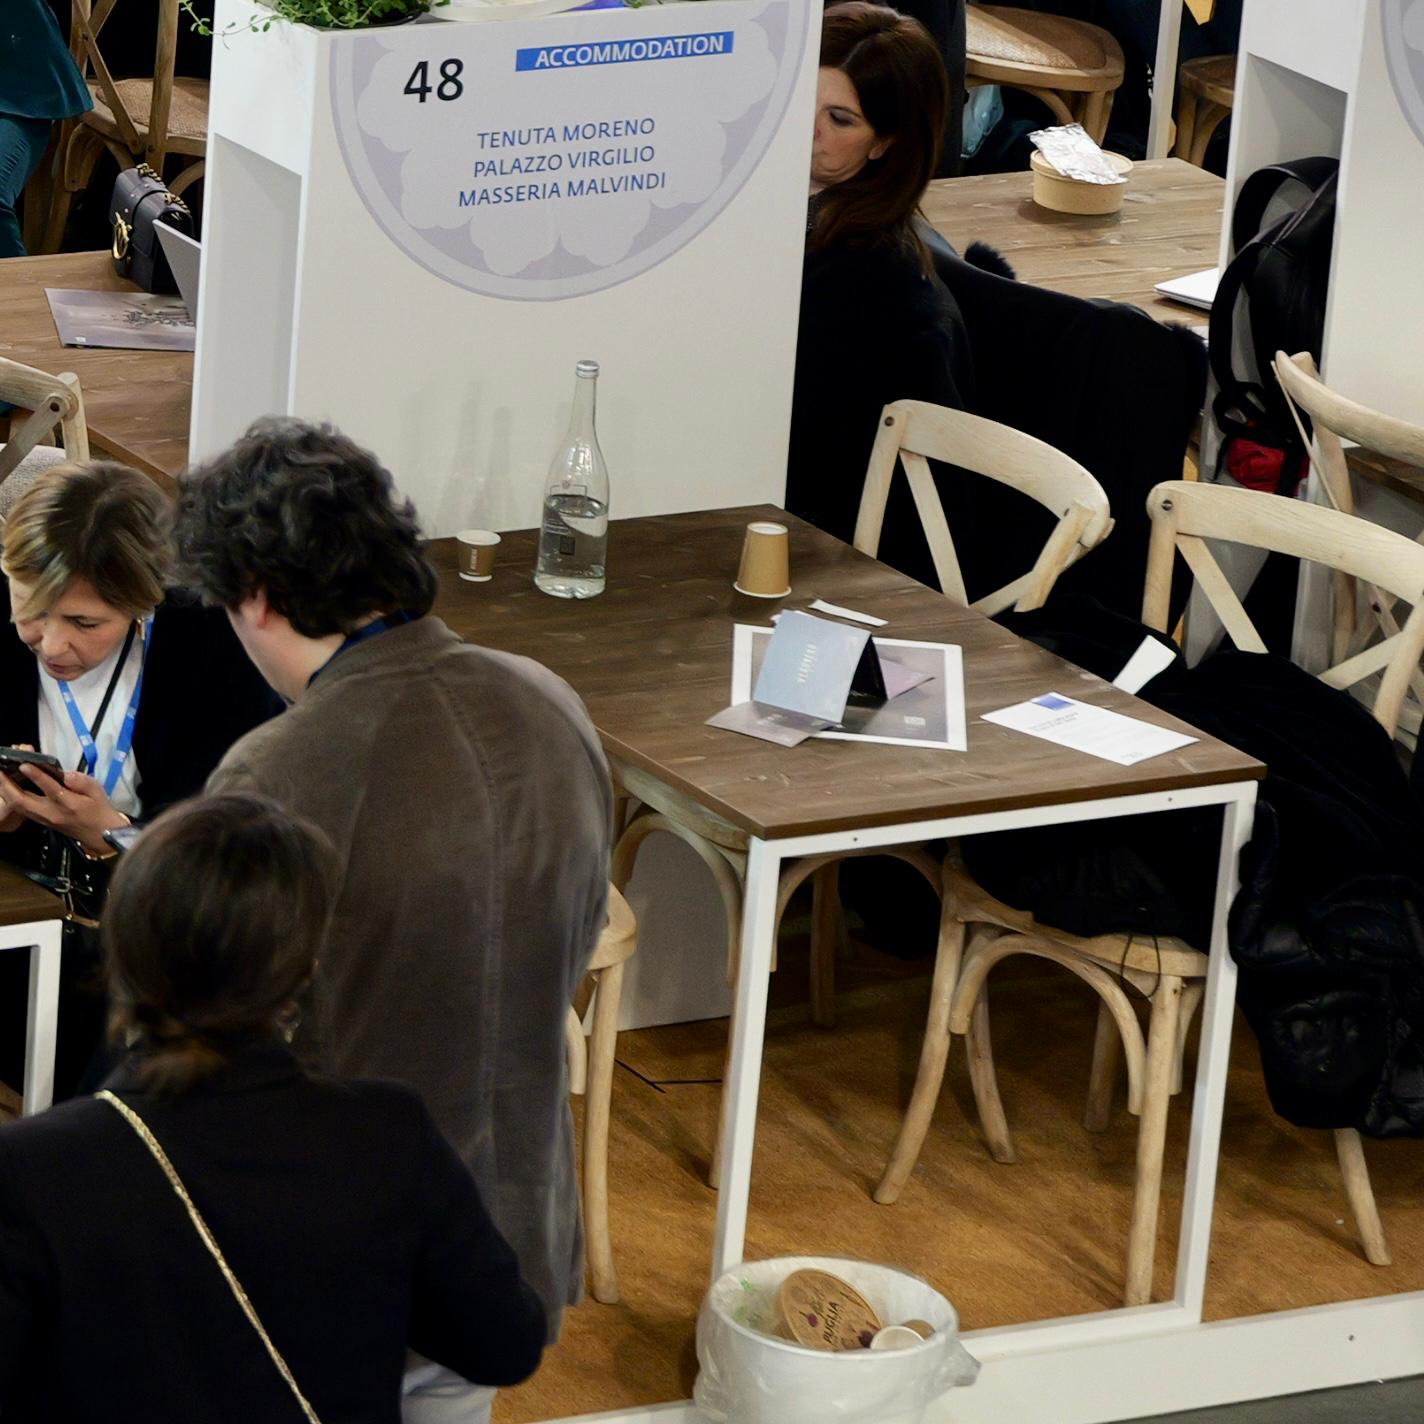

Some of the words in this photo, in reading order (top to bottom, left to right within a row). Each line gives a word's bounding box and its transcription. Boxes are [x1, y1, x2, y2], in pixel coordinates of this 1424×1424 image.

[534, 34, 725, 68] ACCOMMODATION
[403, 58, 464, 103] 48
[477, 126, 557, 149] TENUTA
[562, 117, 656, 142] MORENO
[474, 153, 563, 178] PALAZZO
[567, 145, 655, 169] VIRGILIO
[458, 181, 561, 207] MASSERIA
[567, 172, 666, 198] MALVINDI
[823, 1301, 840, 1344] PUGLIA
